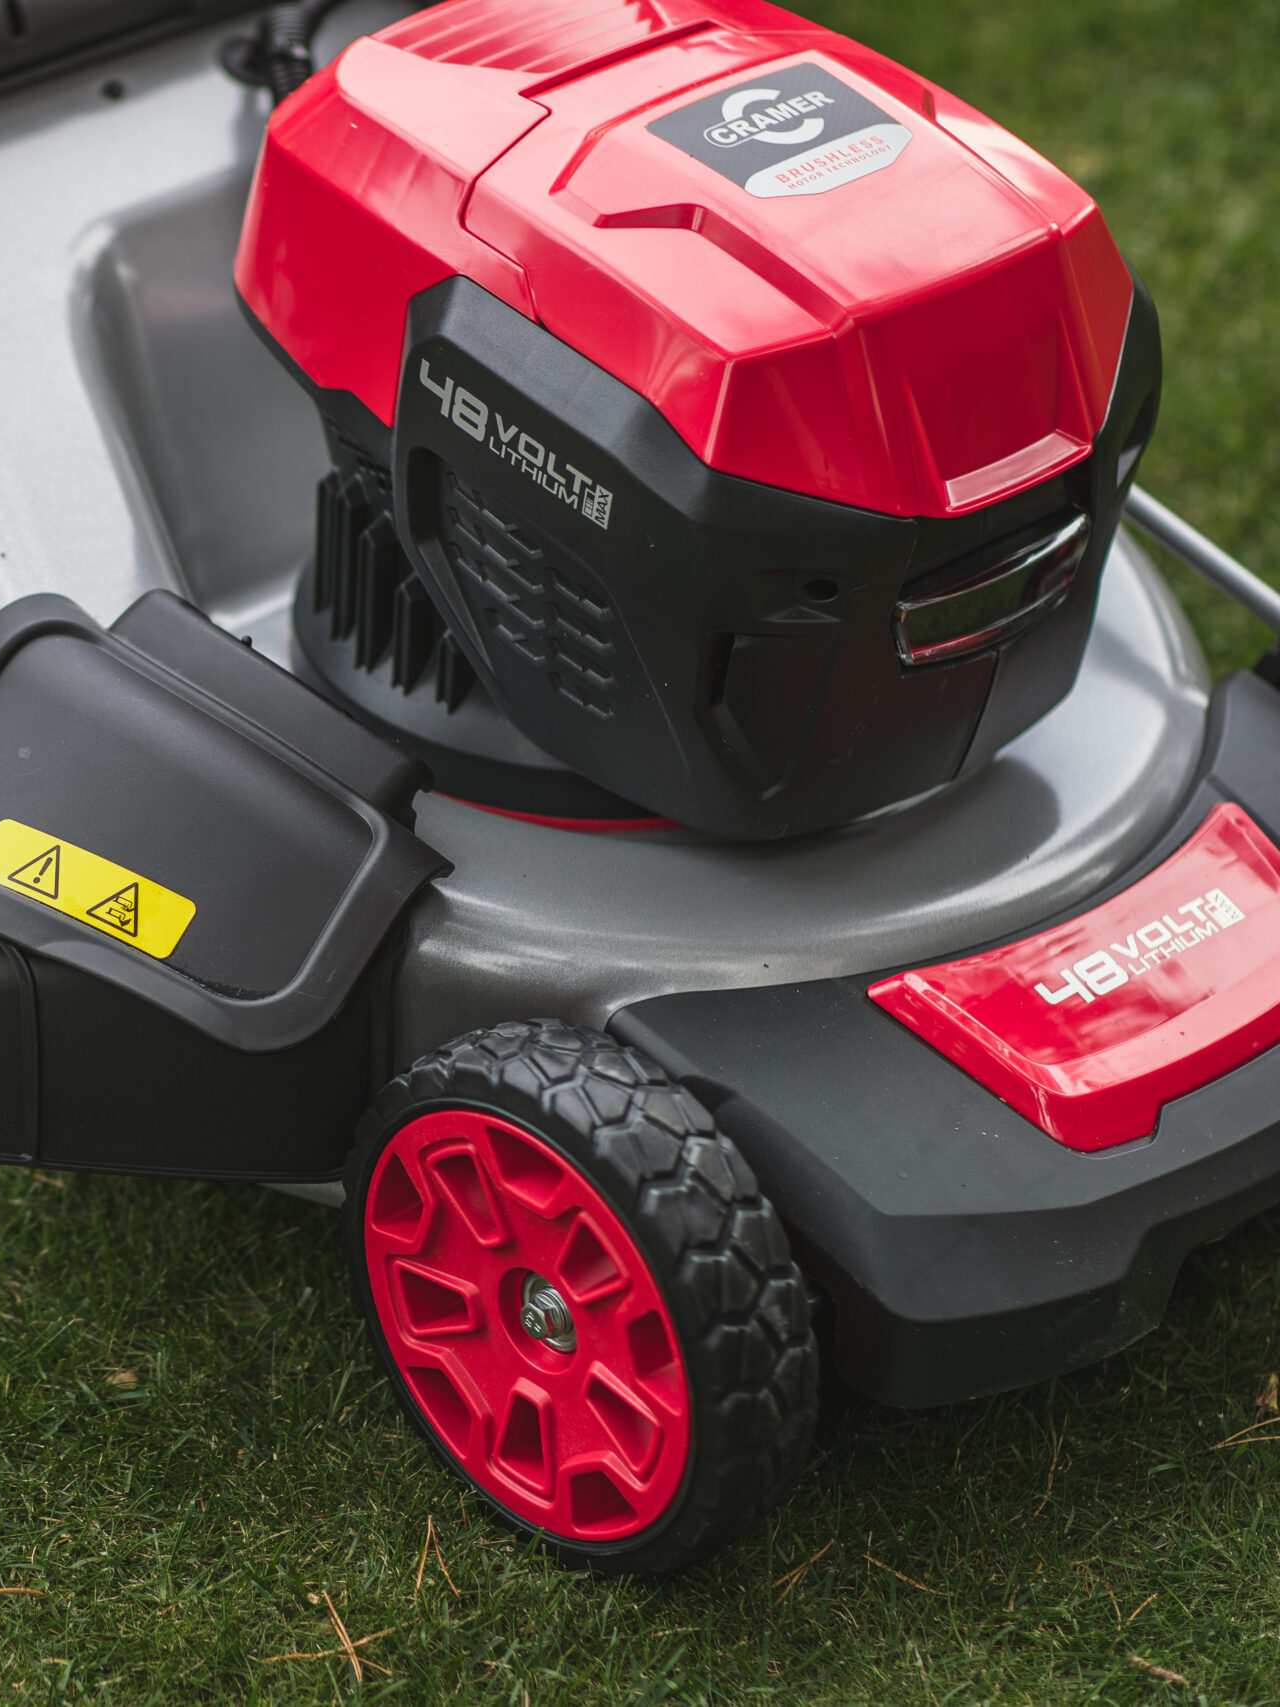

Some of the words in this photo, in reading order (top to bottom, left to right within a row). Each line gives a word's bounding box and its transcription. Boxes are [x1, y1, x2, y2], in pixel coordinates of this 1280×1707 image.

[711, 91, 835, 144] CRAMER
[775, 136, 884, 184] BRUSHLESS
[787, 171, 824, 190] MOTOR
[826, 144, 891, 173] TECHNOLOGY
[420, 358, 488, 442] 48
[495, 412, 593, 496] VOLT
[489, 436, 578, 510] LITHIUM
[595, 489, 610, 525] MAX
[1034, 951, 1129, 1005] 48
[1110, 898, 1207, 959] VOLT
[1127, 921, 1219, 976] LITHIUM
